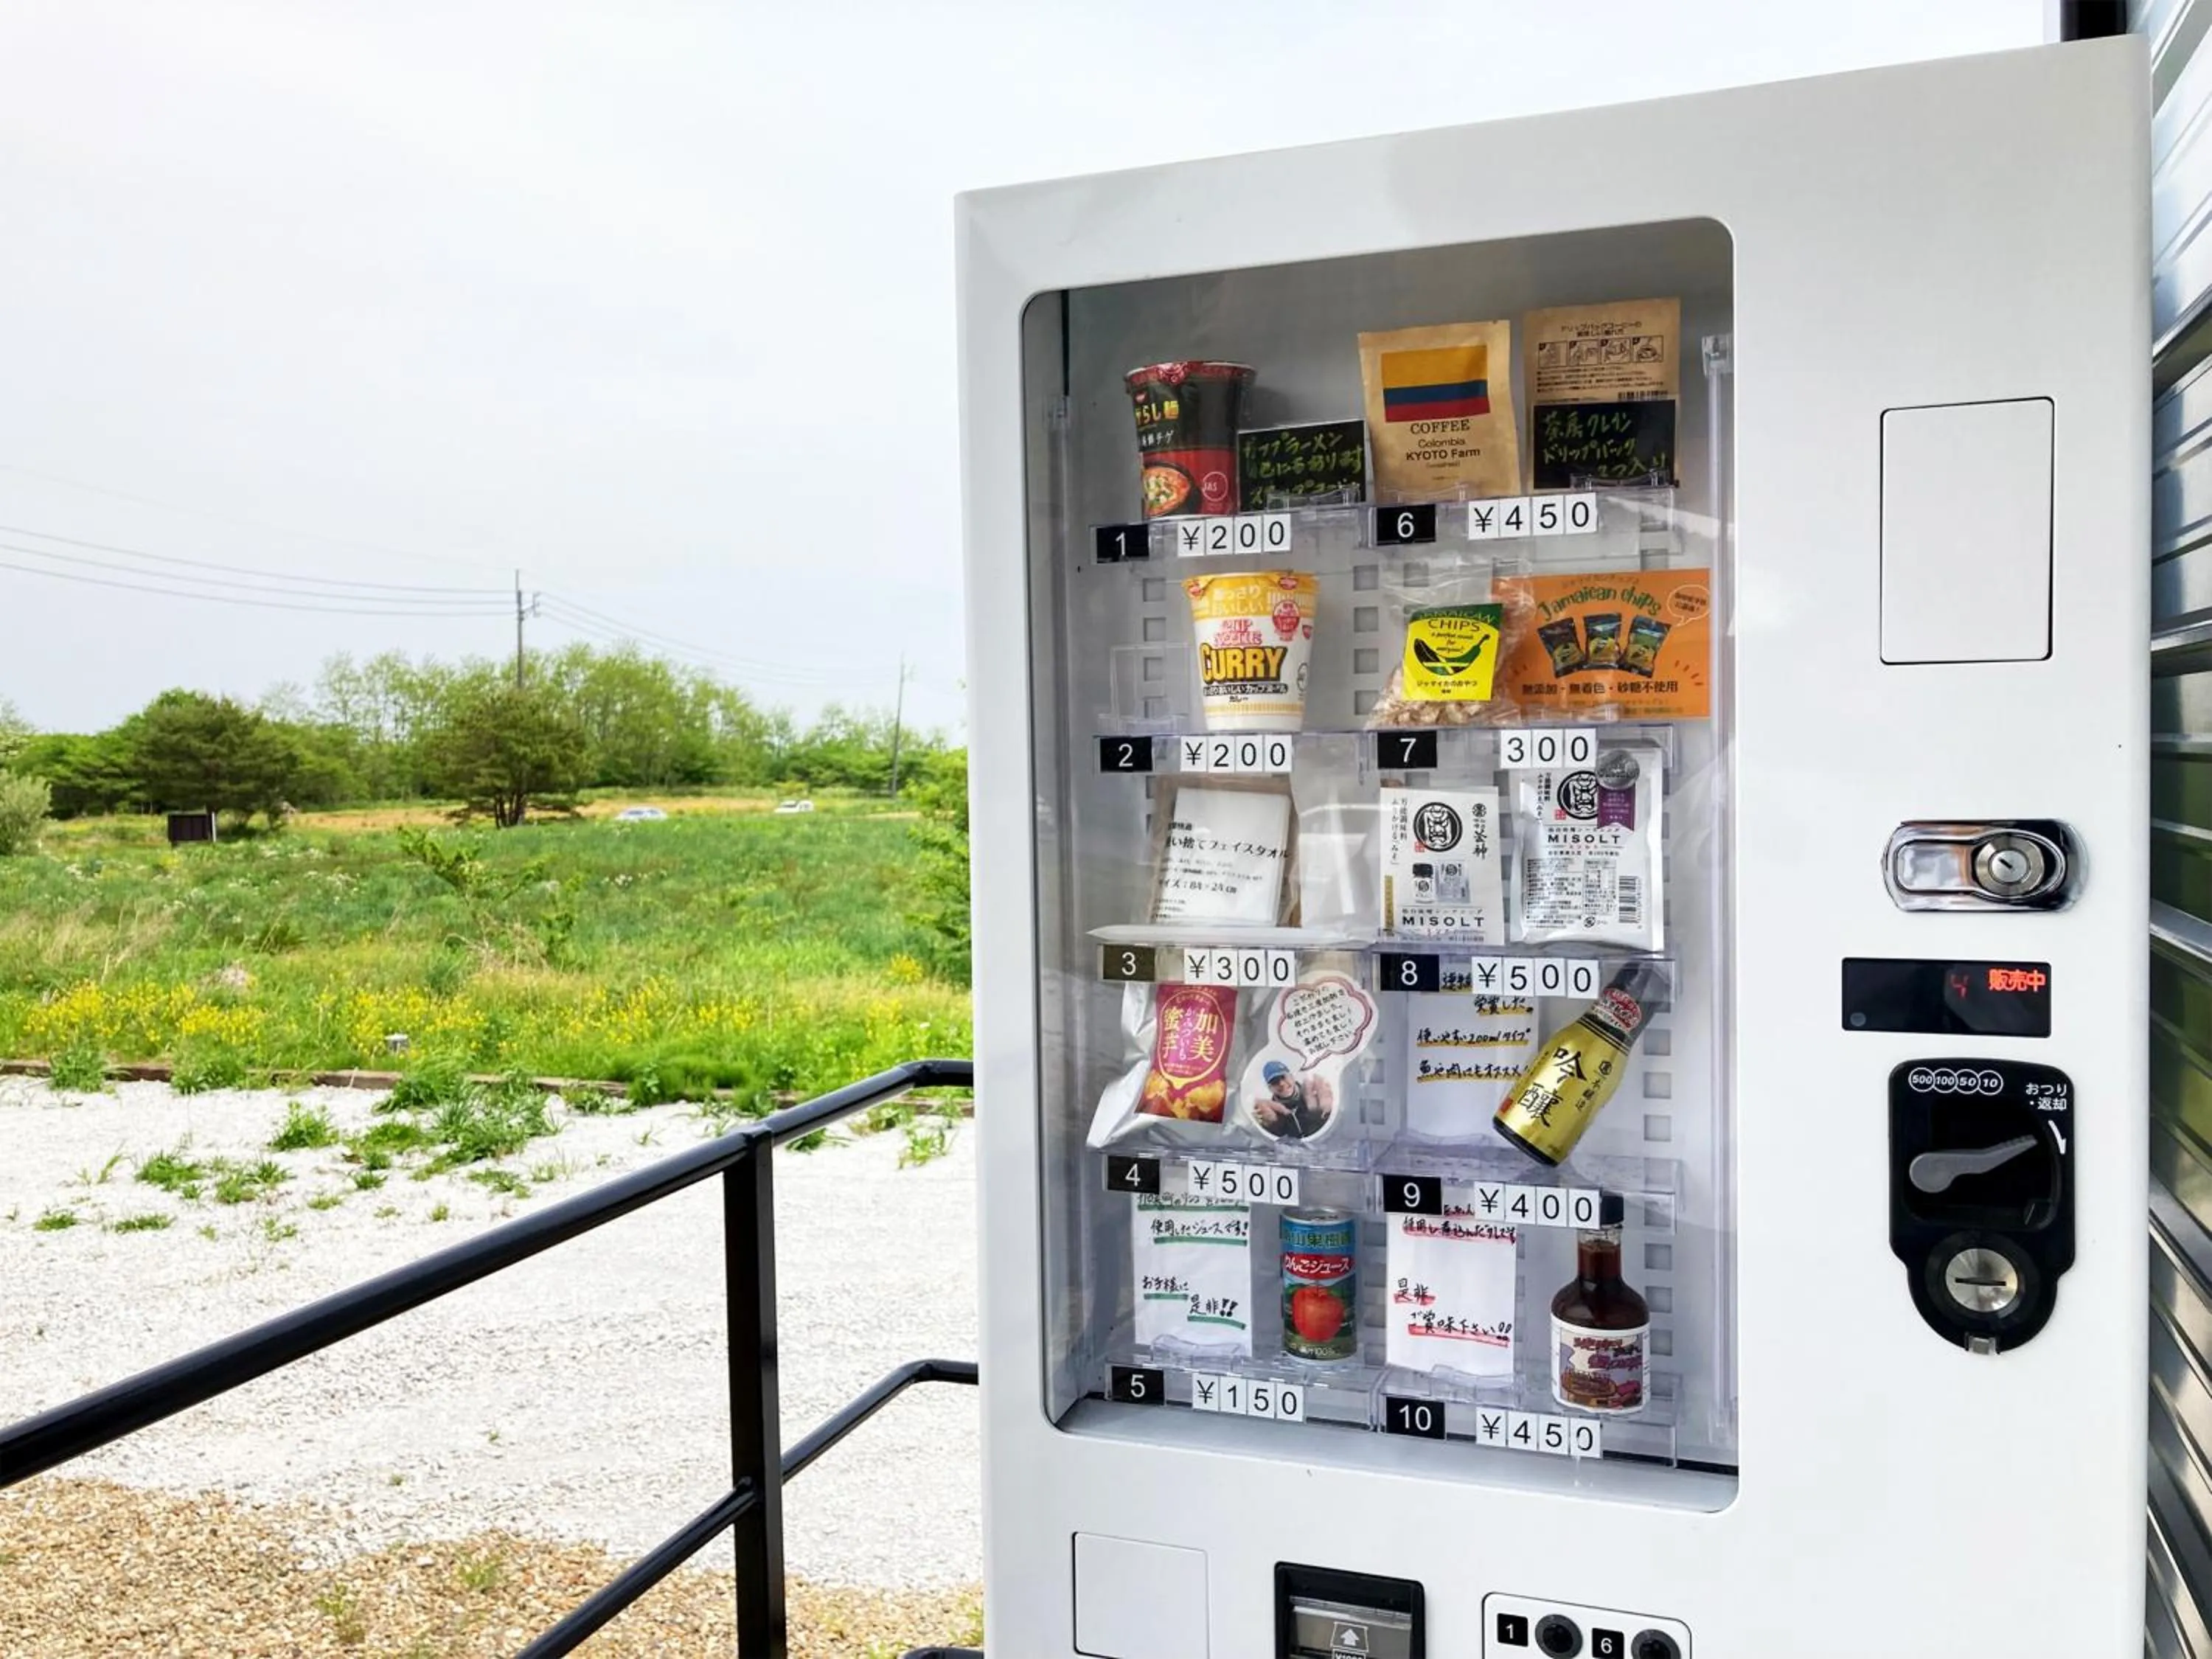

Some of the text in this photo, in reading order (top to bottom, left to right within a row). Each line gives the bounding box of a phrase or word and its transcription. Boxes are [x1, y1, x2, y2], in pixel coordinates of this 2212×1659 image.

[1410, 419, 1470, 434] COFFEE
[1406, 448, 1481, 461] KYOTO Farm
[1418, 438, 1466, 448] Colombia
[1397, 512, 1415, 538] 6
[1473, 501, 1590, 532] ¥450
[1115, 532, 1127, 555] 1
[1181, 521, 1285, 551] ¥200
[1537, 585, 1618, 622] Jamaican
[1621, 585, 1662, 616] chips
[1427, 619, 1481, 632] CHIPS
[1200, 642, 1288, 684] CURRY
[1117, 743, 1134, 768] 2
[1184, 741, 1286, 768] ¥200
[1399, 738, 1417, 764] 7
[1507, 736, 1589, 763] 300
[1548, 834, 1621, 844] MISOLT
[1402, 916, 1484, 927] MISOLT
[1121, 952, 1137, 975] 3
[1189, 954, 1290, 980] ¥300
[1401, 960, 1418, 986] 8
[1477, 963, 1592, 992] ¥500
[1987, 968, 2046, 992] 販売中
[1187, 1007, 1220, 1062] 加美
[1911, 1074, 1933, 1085] 500
[1935, 1075, 1955, 1086] 100
[1959, 1077, 1977, 1087] 50
[1983, 1078, 1998, 1088] 10
[2025, 1082, 2067, 1096] おつり
[1125, 1163, 1141, 1186] 4
[1192, 1165, 1293, 1200] ¥500
[1402, 1182, 1421, 1208] 9
[1479, 1187, 1593, 1222] ¥400
[1143, 1276, 1189, 1293] お子様に
[1397, 1277, 1429, 1302] 是非
[1130, 1374, 1145, 1397] 5
[1196, 1379, 1298, 1415] ¥150
[1398, 1405, 1433, 1433] 10
[1481, 1414, 1593, 1452] ¥450
[1504, 1624, 1514, 1639] 1
[1600, 1637, 1613, 1655] 6
